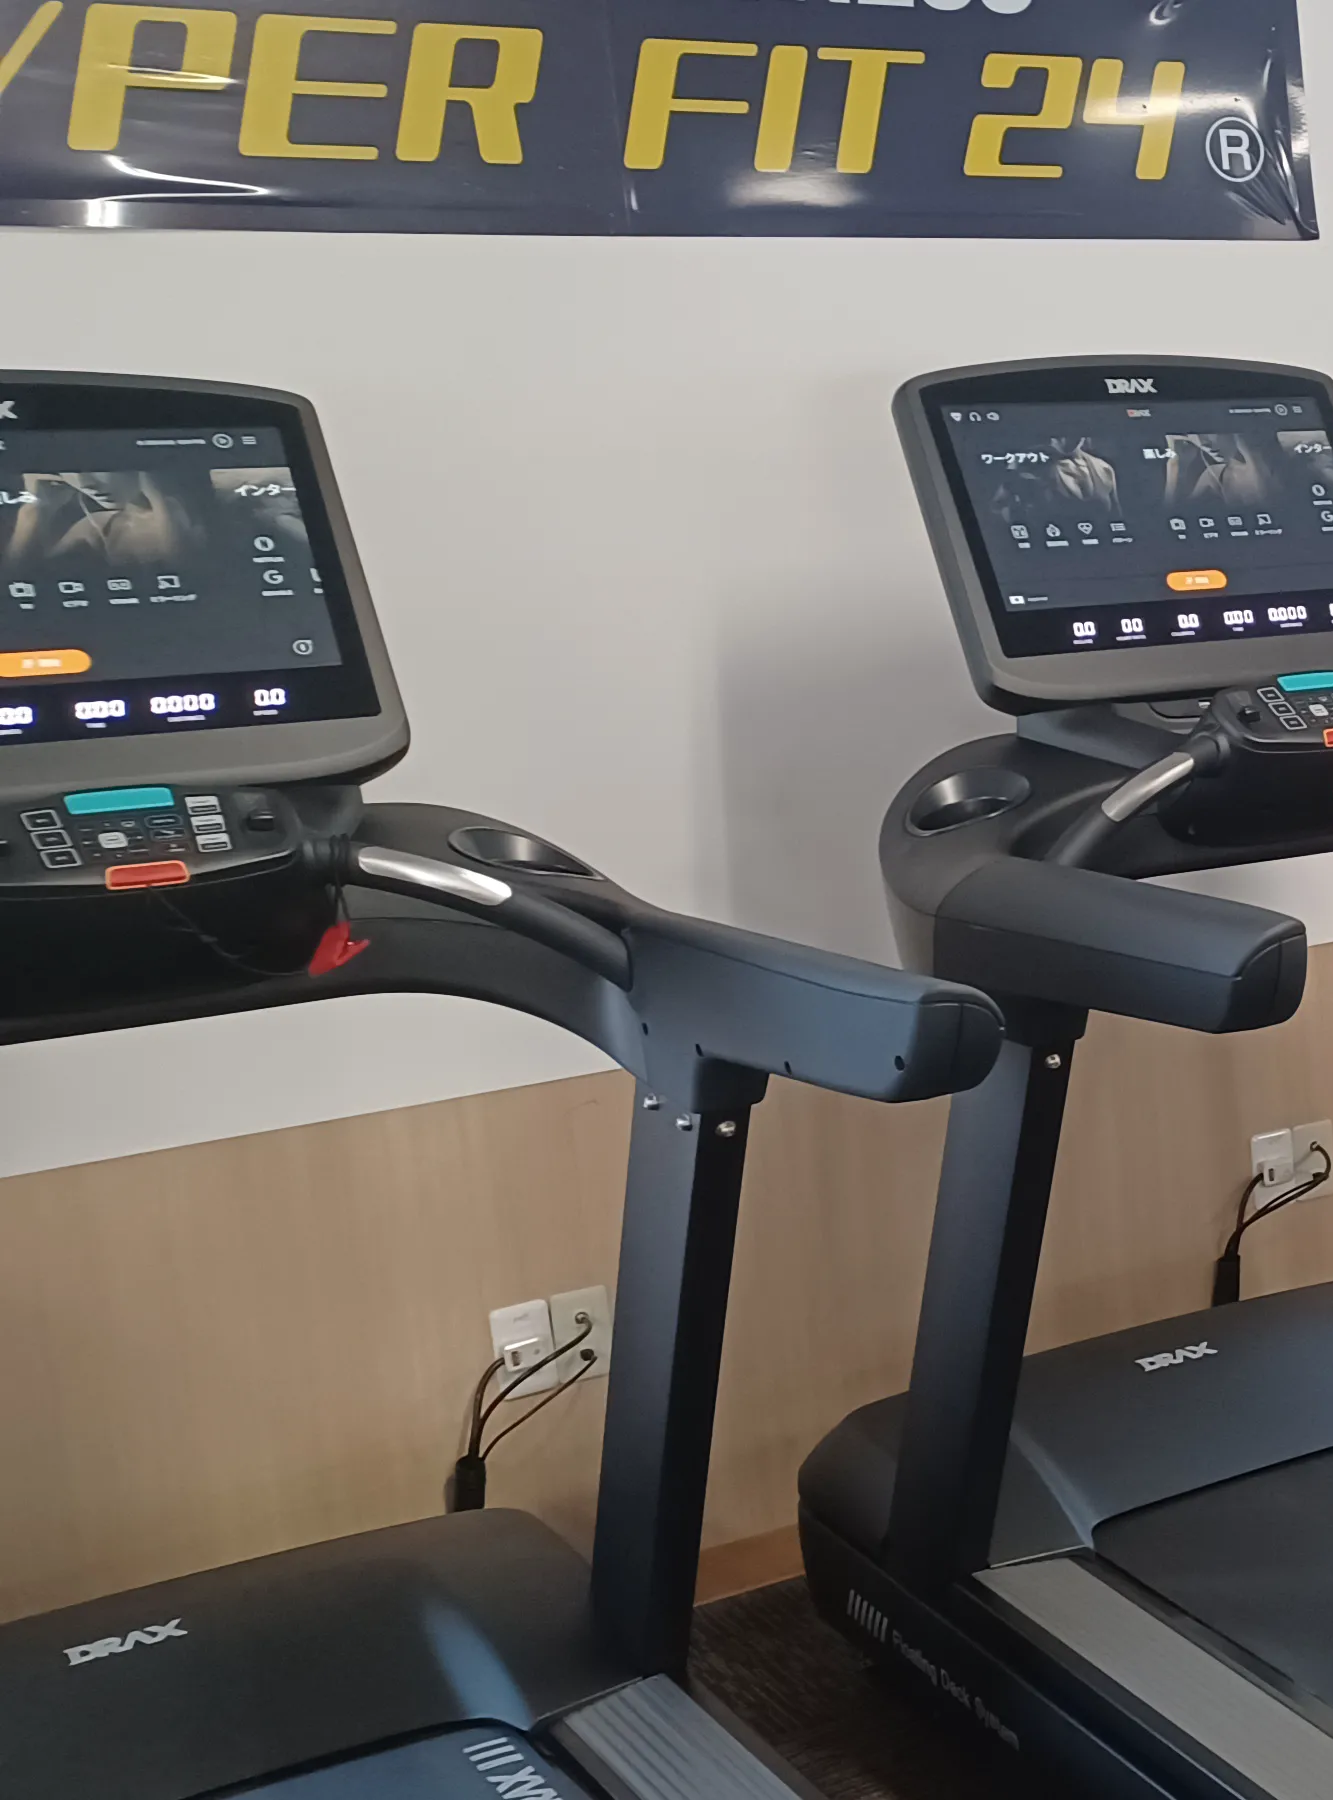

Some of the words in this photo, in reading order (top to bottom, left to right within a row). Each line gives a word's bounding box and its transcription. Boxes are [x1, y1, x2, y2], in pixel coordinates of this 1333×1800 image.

[623, 38, 926, 173] FIT
[963, 53, 1185, 180] 24
[1104, 378, 1158, 393] DRAX
[981, 452, 1050, 464] ワークアウト
[1135, 1341, 1218, 1372] DRAX
[63, 1617, 188, 1666] DRAX
